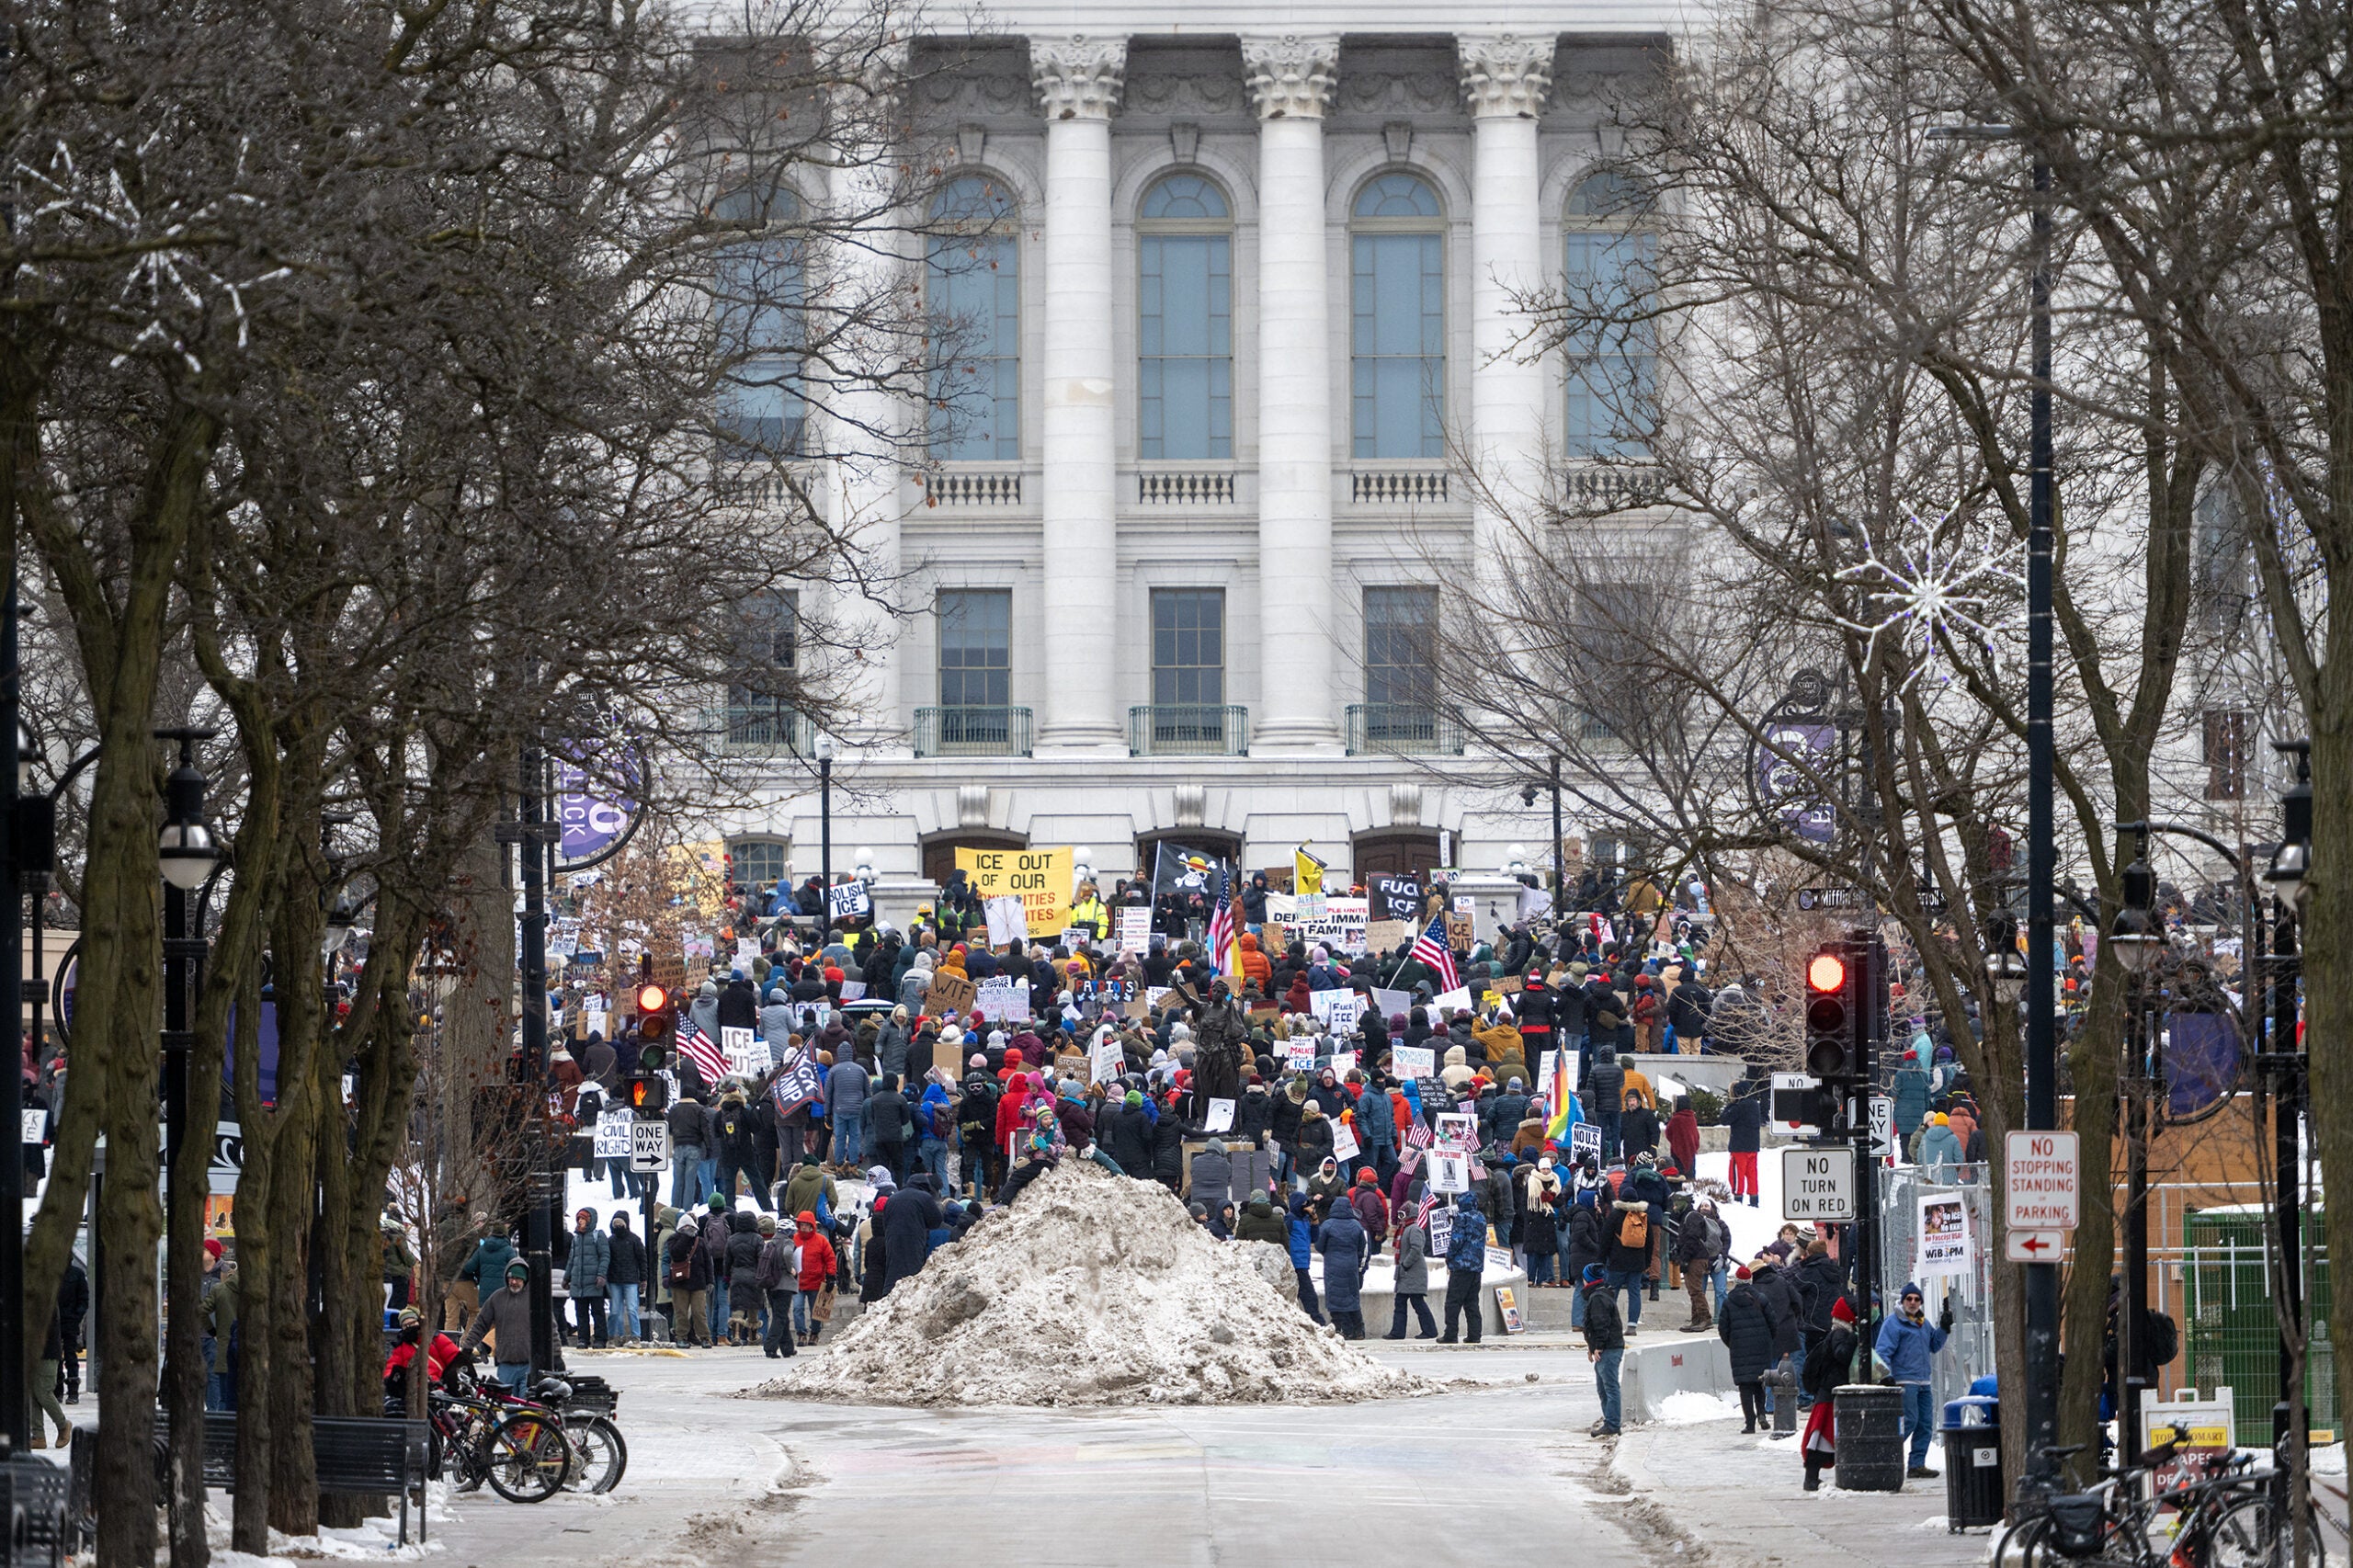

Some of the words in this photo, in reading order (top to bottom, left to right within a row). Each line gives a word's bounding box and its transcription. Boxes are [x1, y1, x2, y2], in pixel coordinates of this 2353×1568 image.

[976, 854, 1004, 869] ICE
[1018, 853, 1053, 870] OUT
[982, 873, 999, 887] OF
[1010, 873, 1045, 890] OUR
[829, 882, 867, 903] BOLISH
[1821, 889, 1851, 907] Mifflin
[836, 898, 859, 915] ICE
[1308, 925, 1342, 935] FAMI
[1449, 923, 1470, 937] ICE
[1449, 937, 1472, 950] OUT
[934, 974, 972, 1001] WTF
[1076, 980, 1134, 994] PATRIOTS
[1319, 992, 1343, 1005] ICE
[1335, 1013, 1352, 1022] ICE
[724, 1029, 750, 1050] ICE
[1290, 1047, 1314, 1055] MALICE
[1294, 1060, 1313, 1069] ICE
[1054, 1068, 1087, 1078] GESTAPO
[602, 1109, 633, 1124] DEMAND
[1868, 1104, 1886, 1118] NE
[603, 1124, 630, 1138] CIVIL
[636, 1127, 663, 1138] ONE
[1869, 1120, 1886, 1133] AY
[1574, 1130, 1585, 1143] NO
[596, 1140, 631, 1154] RIGHTS
[635, 1141, 663, 1153] WAY
[2031, 1138, 2053, 1156] NO
[1807, 1157, 1829, 1174] NO
[2012, 1160, 2074, 1175] STOPPING
[1801, 1179, 1836, 1193] TURN
[2012, 1178, 2074, 1192] STANDING
[1792, 1199, 1810, 1212] ON
[1818, 1198, 1846, 1212] RED
[2016, 1205, 2070, 1220] PARKING
[1432, 1222, 1449, 1231] MINNEA
[1433, 1231, 1451, 1240] STO
[1932, 1233, 1950, 1242] Fascist
[2154, 1432, 2224, 1443] TOBOMART
